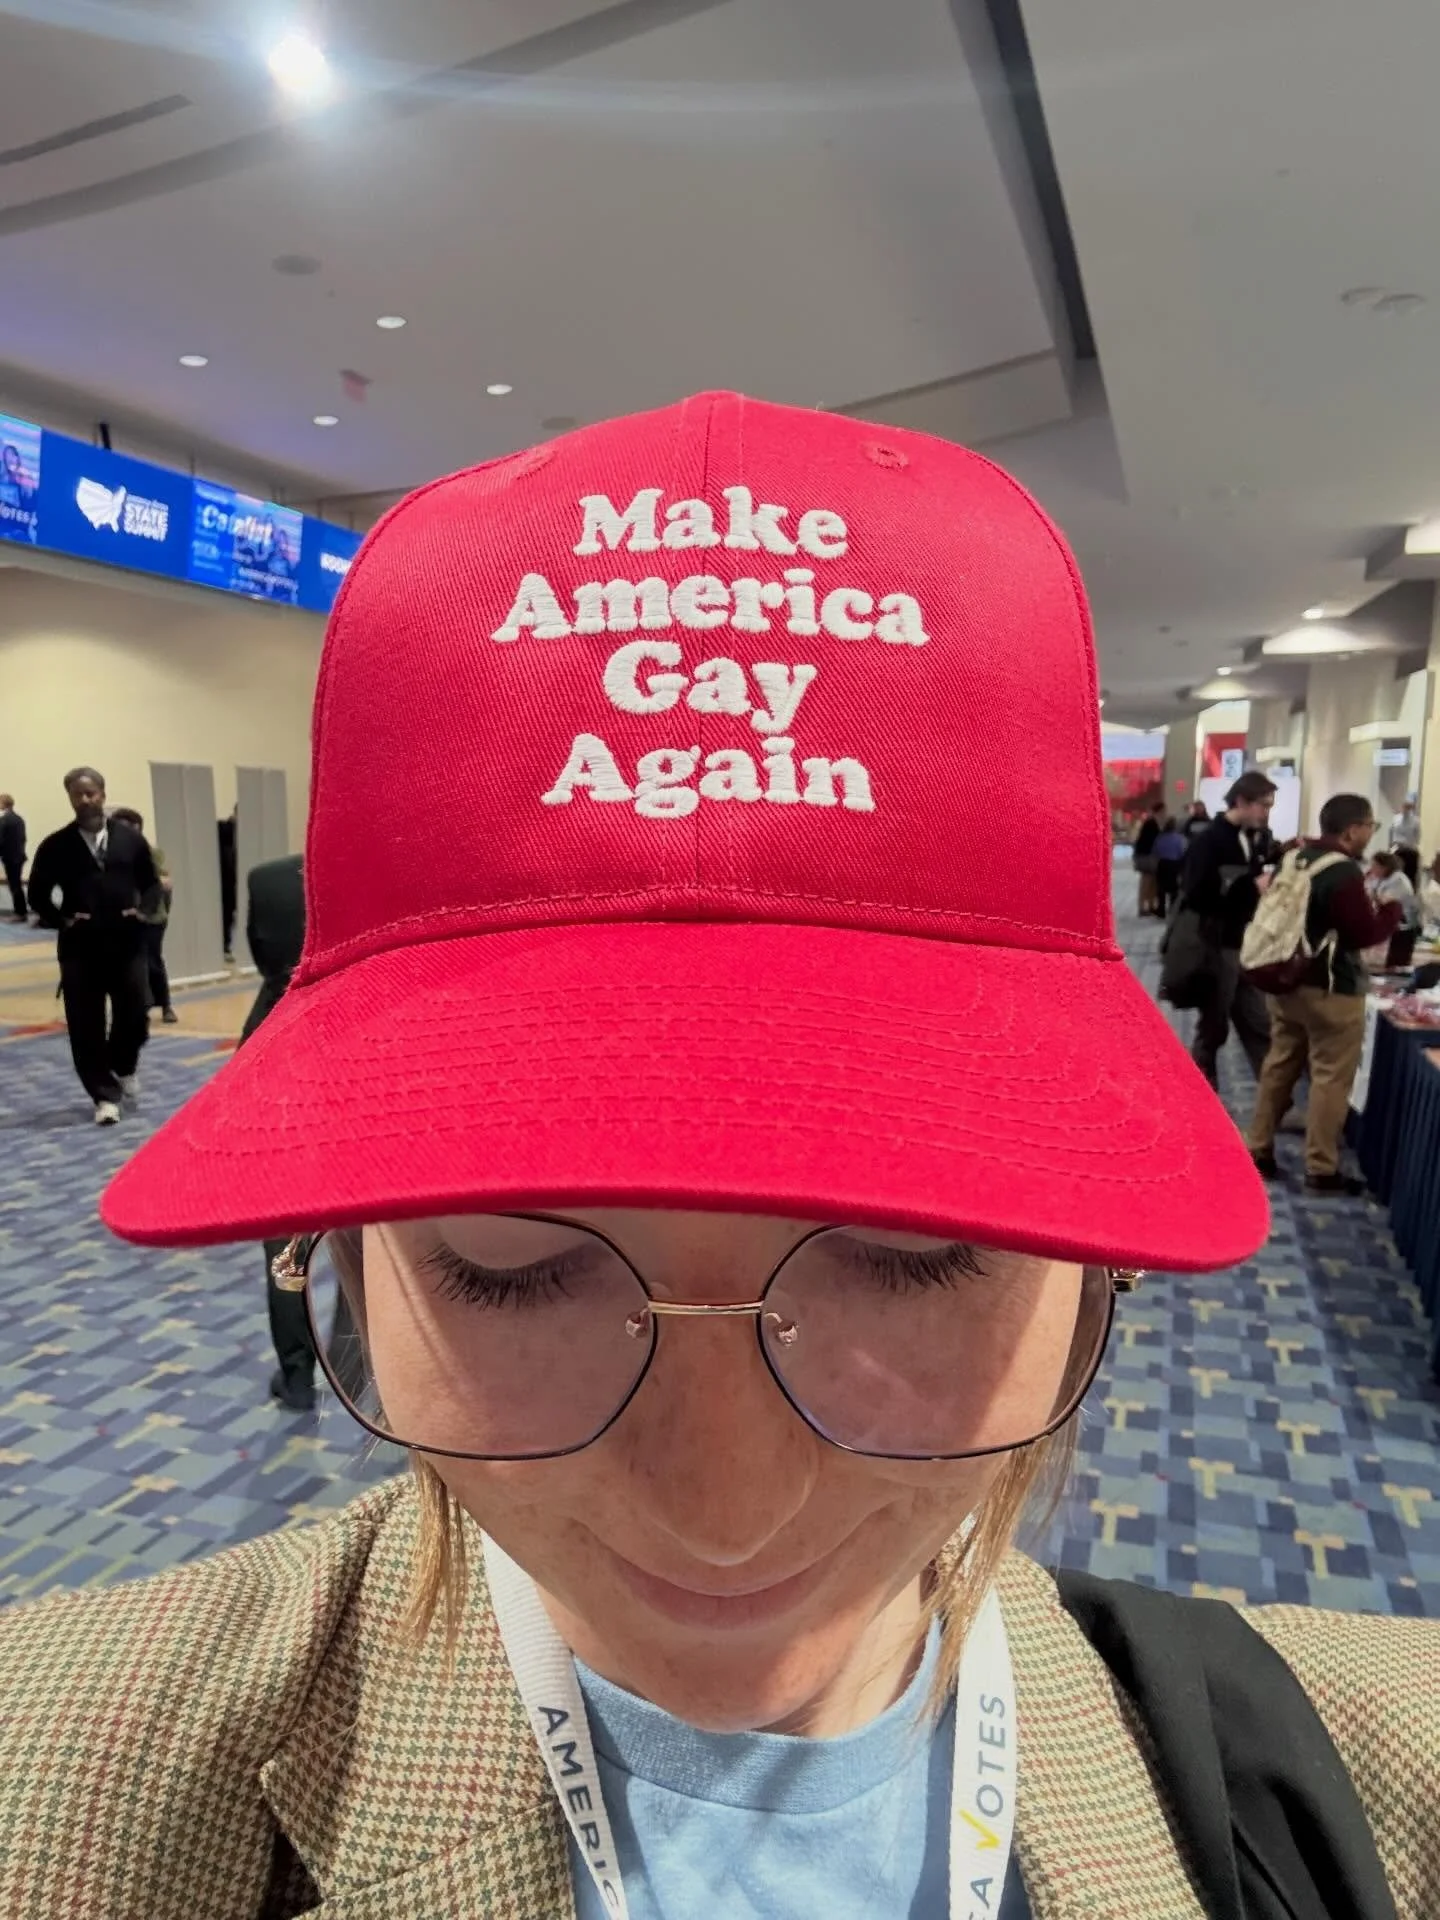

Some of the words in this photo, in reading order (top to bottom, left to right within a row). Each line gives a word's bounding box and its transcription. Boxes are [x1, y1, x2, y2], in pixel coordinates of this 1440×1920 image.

[572, 485, 849, 560] Make
[490, 567, 931, 648] America
[602, 639, 818, 735] Gay
[540, 732, 876, 819] Again
